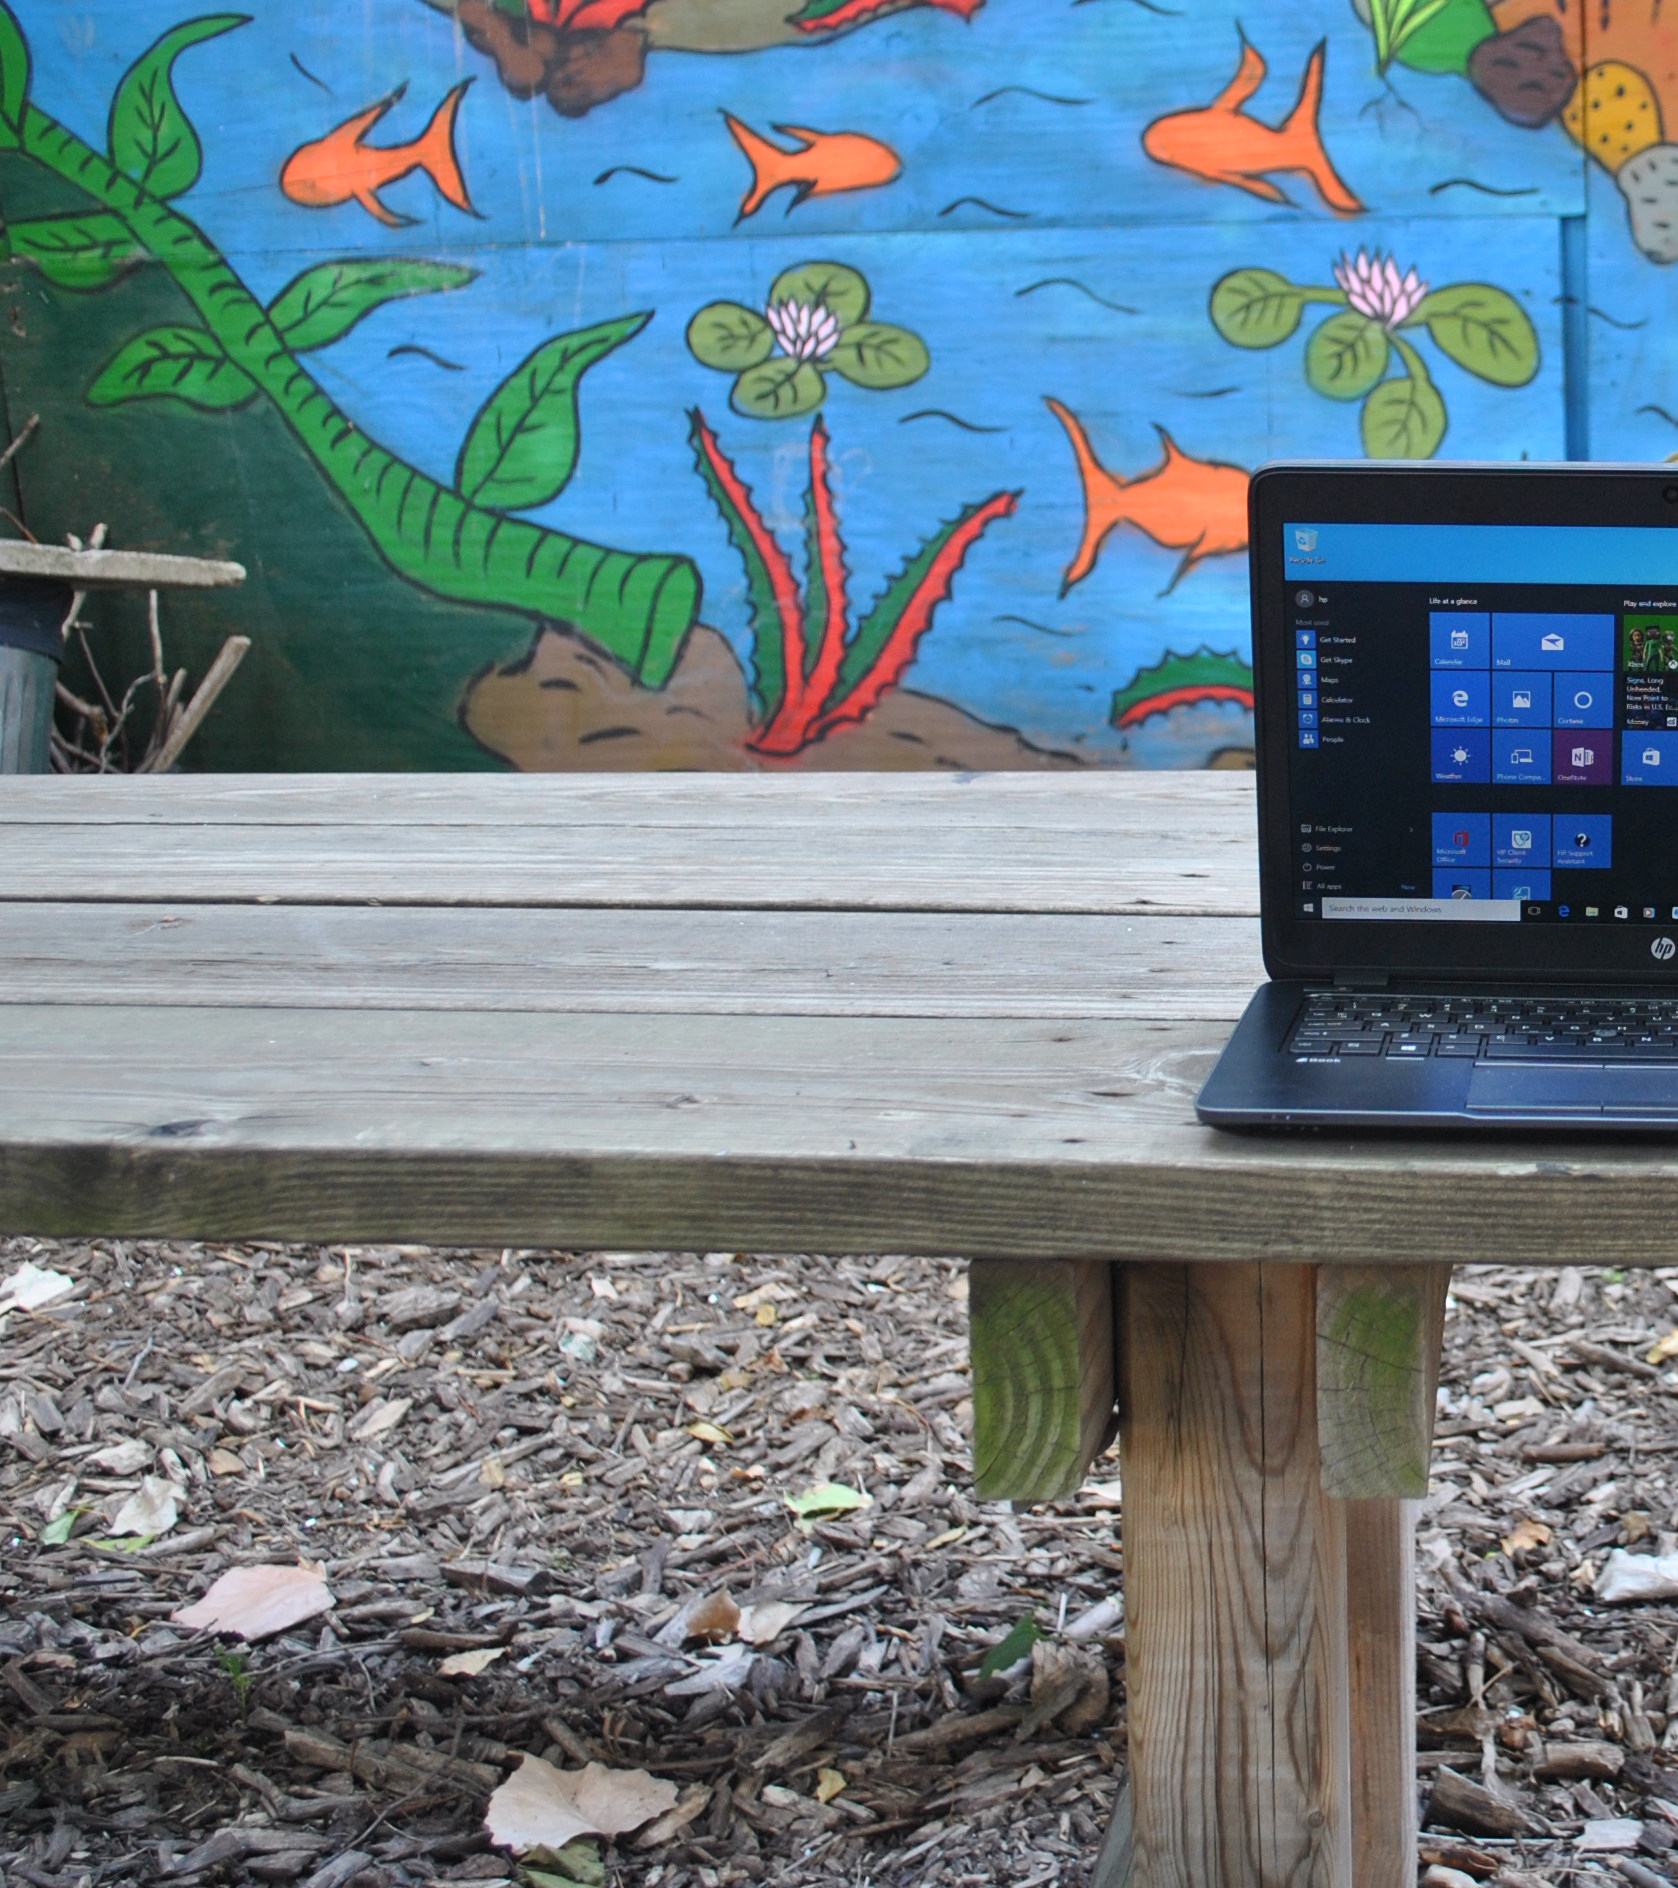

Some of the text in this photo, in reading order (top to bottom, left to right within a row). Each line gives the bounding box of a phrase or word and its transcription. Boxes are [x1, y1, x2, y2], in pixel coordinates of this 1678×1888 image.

[1623, 601, 1637, 609] Play
[1329, 904, 1355, 912] Search
[1406, 905, 1442, 914] Windows
[1651, 937, 1676, 960] hp
